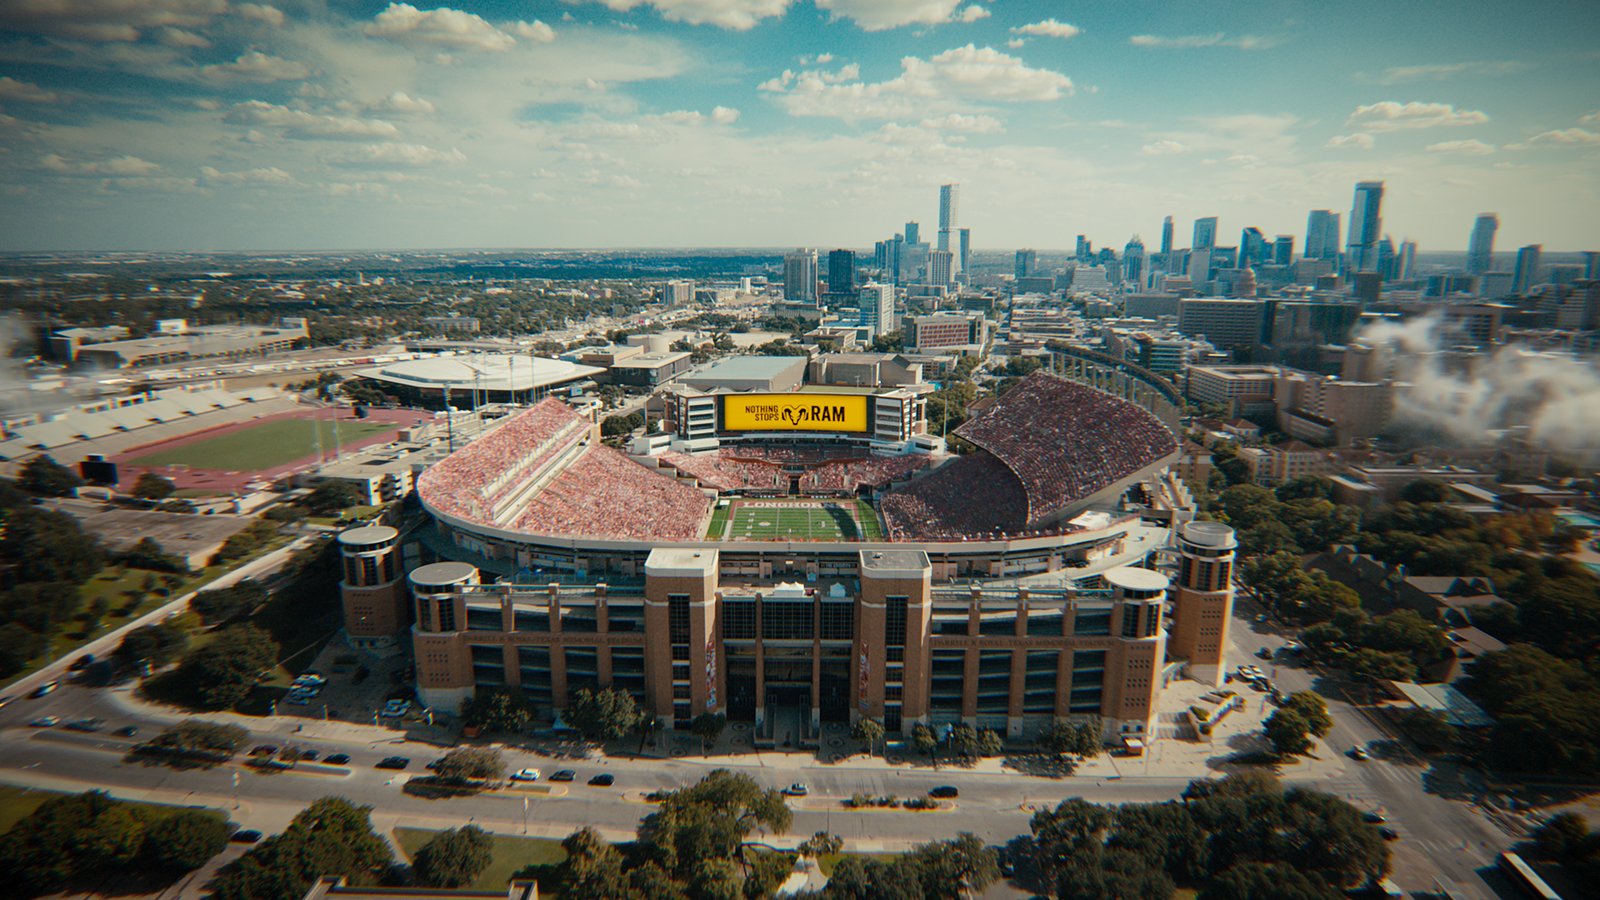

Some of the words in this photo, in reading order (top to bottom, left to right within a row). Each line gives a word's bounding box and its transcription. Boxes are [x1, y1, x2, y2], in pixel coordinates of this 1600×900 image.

[745, 405, 779, 414] NOTHING
[811, 405, 846, 422] RAM
[755, 413, 779, 421] STOPS
